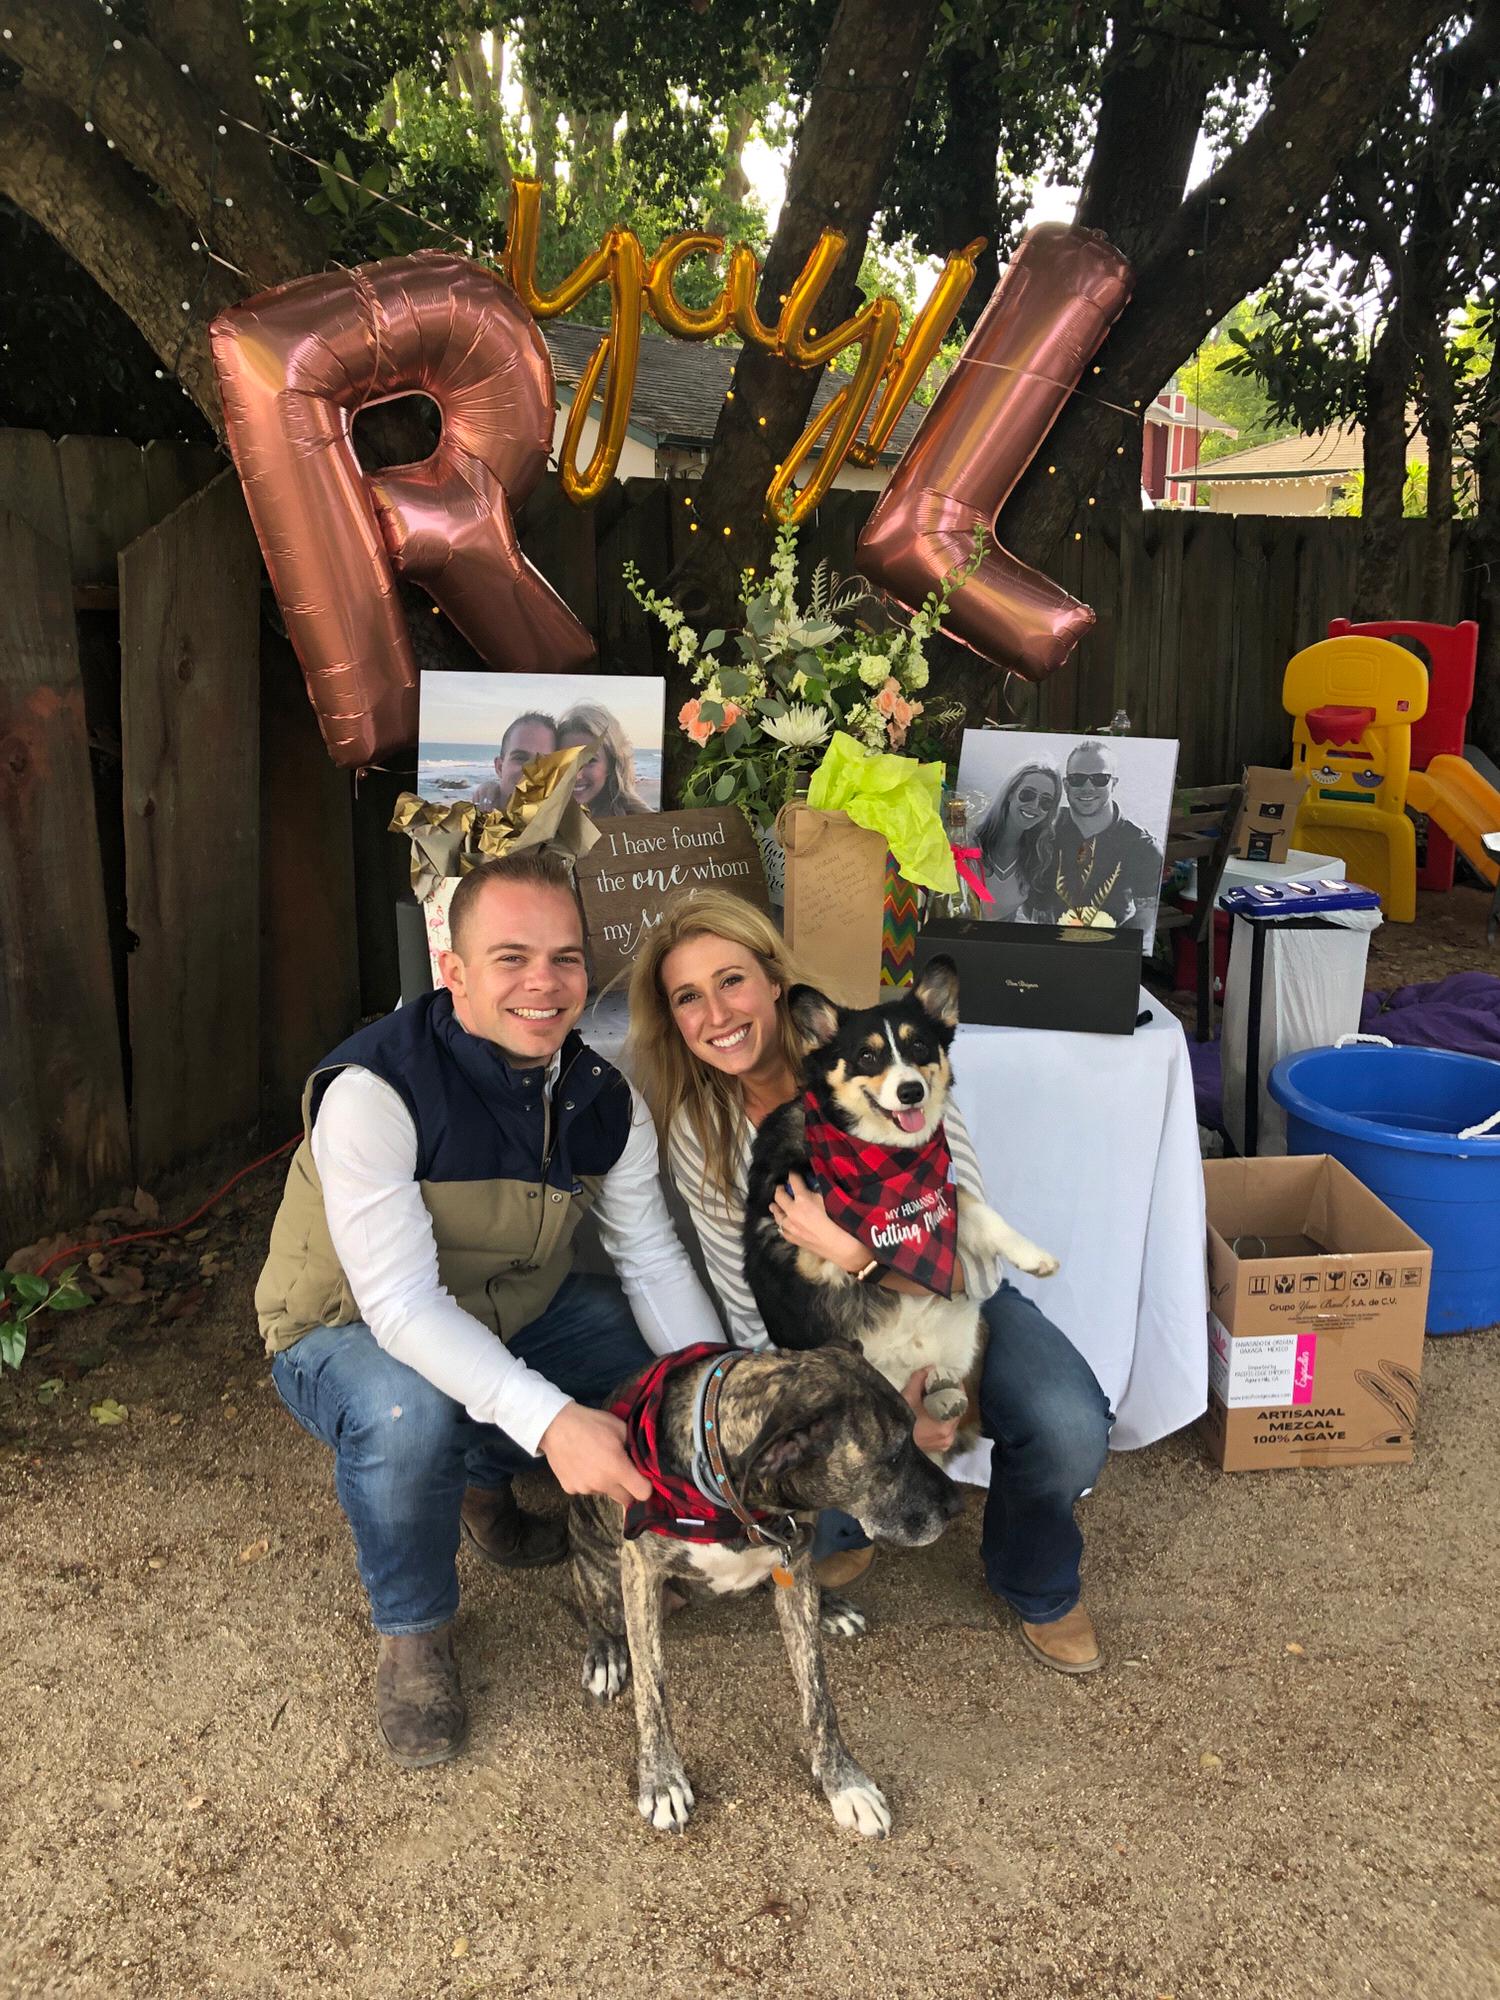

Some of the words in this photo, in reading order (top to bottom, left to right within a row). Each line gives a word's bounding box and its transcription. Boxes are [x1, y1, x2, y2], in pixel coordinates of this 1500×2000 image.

[856, 222, 1136, 681] L
[210, 249, 597, 768] R
[608, 833, 619, 857] I
[622, 832, 667, 856] have
[671, 822, 726, 850] found
[597, 868, 626, 893] the
[632, 864, 690, 893] one
[691, 857, 750, 881] whom
[603, 922, 632, 948] my
[884, 1207, 900, 1221] MY
[900, 1193, 936, 1217] HUMANS
[870, 1222, 922, 1248] Getting
[1269, 1303, 1296, 1312] Grupo
[1368, 1298, 1379, 1306] de
[1381, 1296, 1398, 1306] C.V.
[1256, 1407, 1345, 1420] ARTISANAL
[1268, 1420, 1334, 1432] MEZCAL
[1253, 1432, 1290, 1444] 100%
[1291, 1431, 1346, 1443] AGAVE
